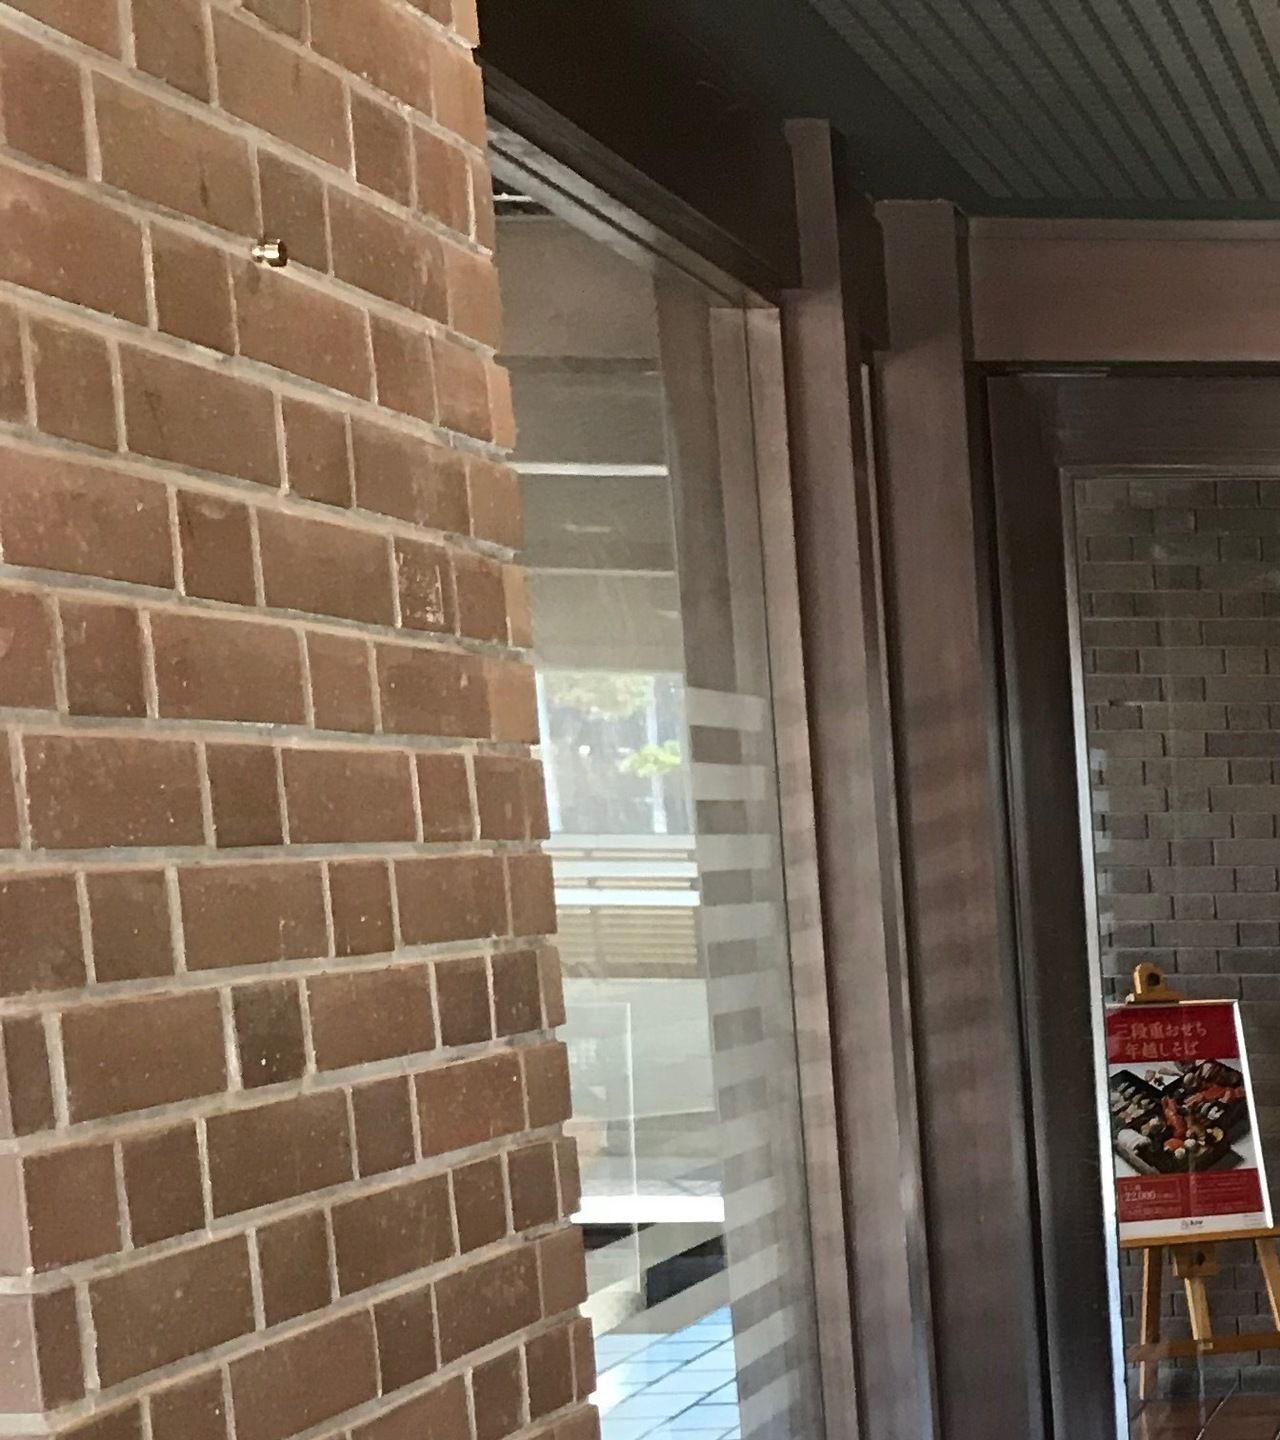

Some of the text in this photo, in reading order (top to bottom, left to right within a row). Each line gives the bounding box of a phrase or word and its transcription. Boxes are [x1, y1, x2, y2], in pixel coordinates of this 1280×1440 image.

[1113, 1021, 1208, 1040] 三段重おせち
[1125, 1041, 1199, 1059] 年越しそば
